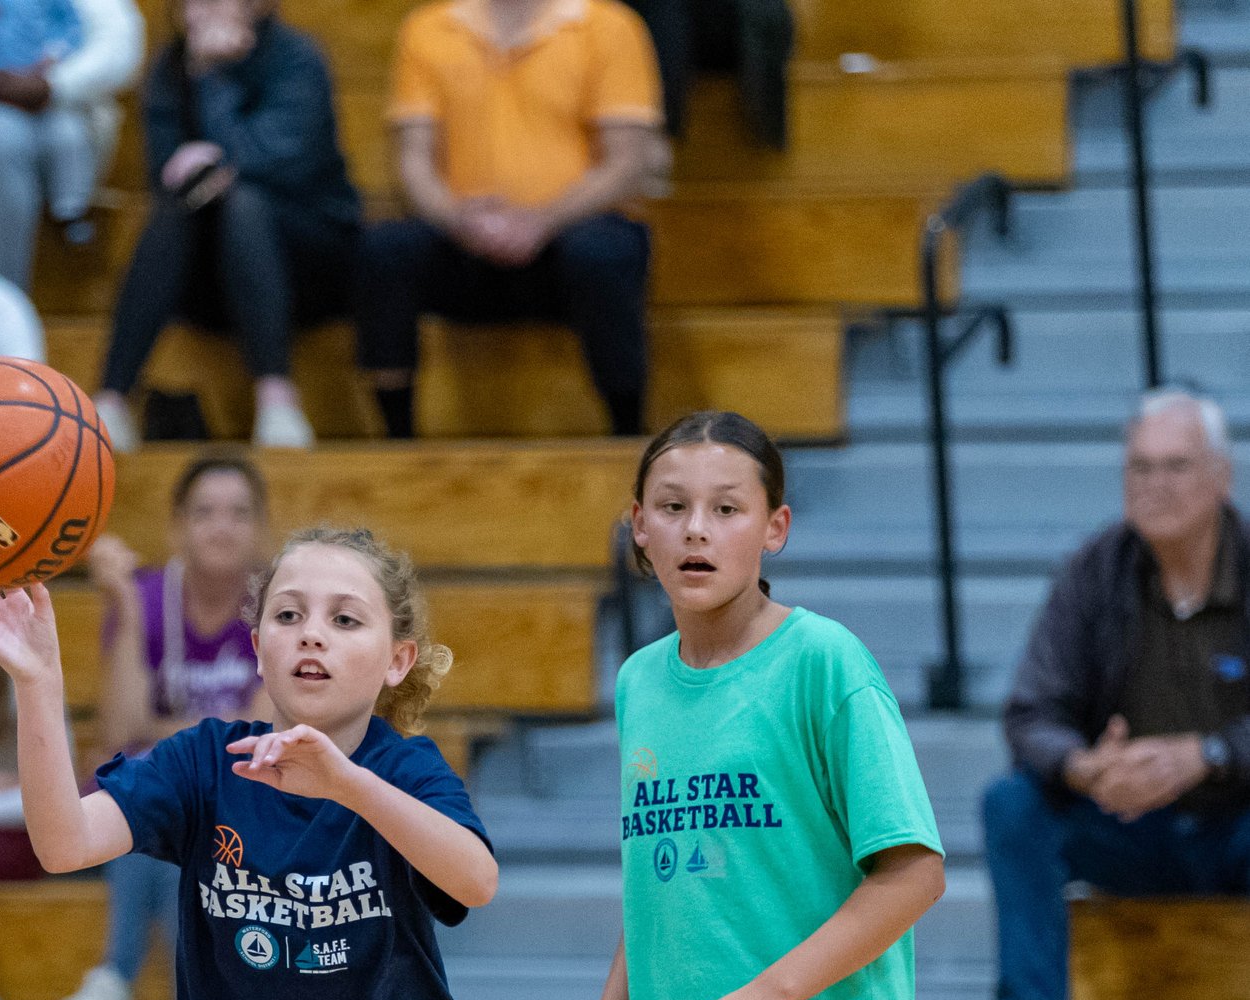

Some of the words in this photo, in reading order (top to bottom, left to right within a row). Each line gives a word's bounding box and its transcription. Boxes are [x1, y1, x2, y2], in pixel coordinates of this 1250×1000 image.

[634, 778, 680, 808] ALL
[687, 773, 761, 801] STAR
[622, 803, 782, 841] BASKETBALL
[211, 862, 281, 897] ALL
[284, 860, 378, 903] STAR
[198, 881, 393, 930] BASKETBALL
[312, 938, 351, 955] S.A.F.E.
[317, 951, 349, 967] TEAM
